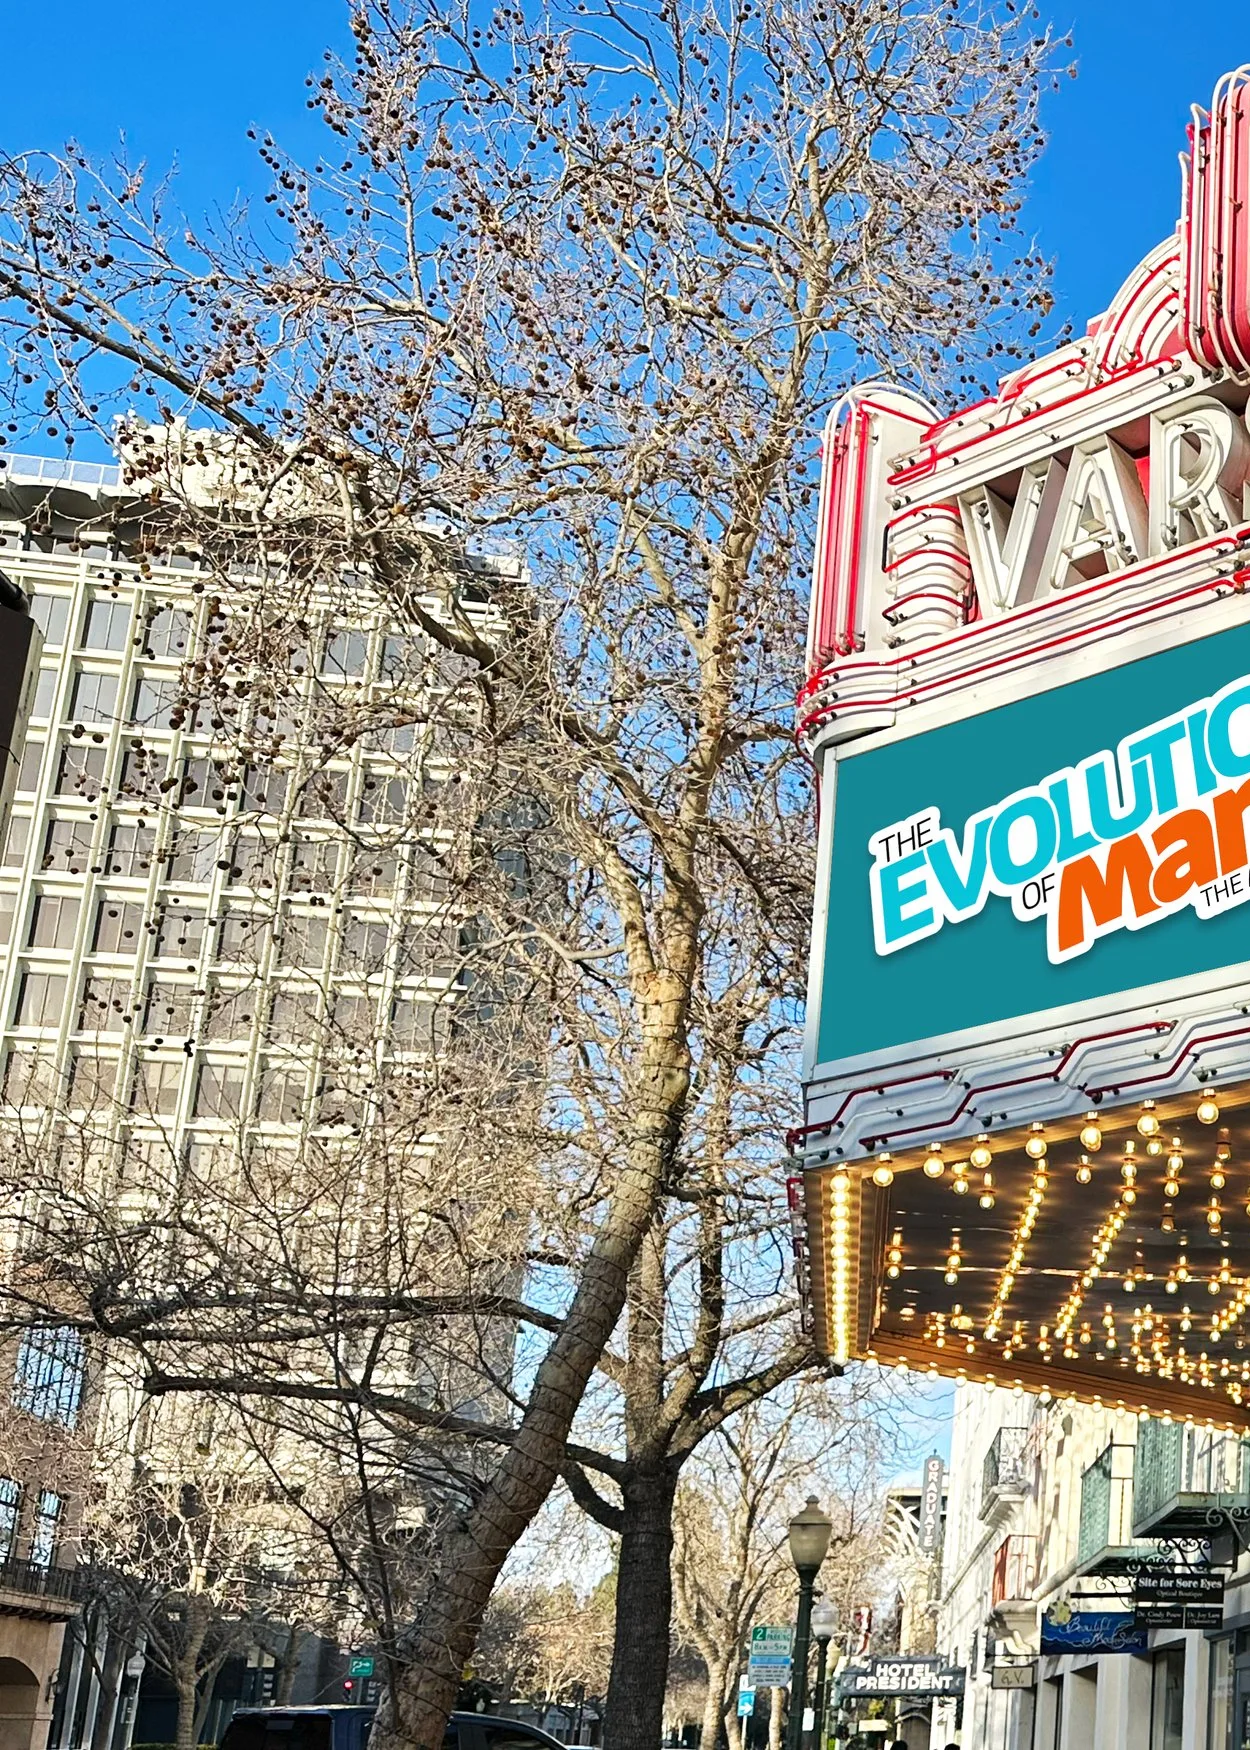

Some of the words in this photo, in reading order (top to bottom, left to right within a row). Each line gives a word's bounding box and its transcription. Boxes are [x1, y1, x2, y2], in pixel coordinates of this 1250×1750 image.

[878, 817, 933, 862] THE
[1022, 873, 1055, 909] OF
[1200, 873, 1243, 907] THE
[923, 1460, 940, 1547] GRADUATE
[1138, 1577, 1158, 1588] Site
[1160, 1578, 1174, 1588] for
[1176, 1578, 1199, 1588] Sore
[1200, 1579, 1222, 1590] Eyes
[756, 1628, 764, 1640] 2
[876, 1663, 935, 1677] HOTEL
[856, 1676, 953, 1690] PRESIDENT
